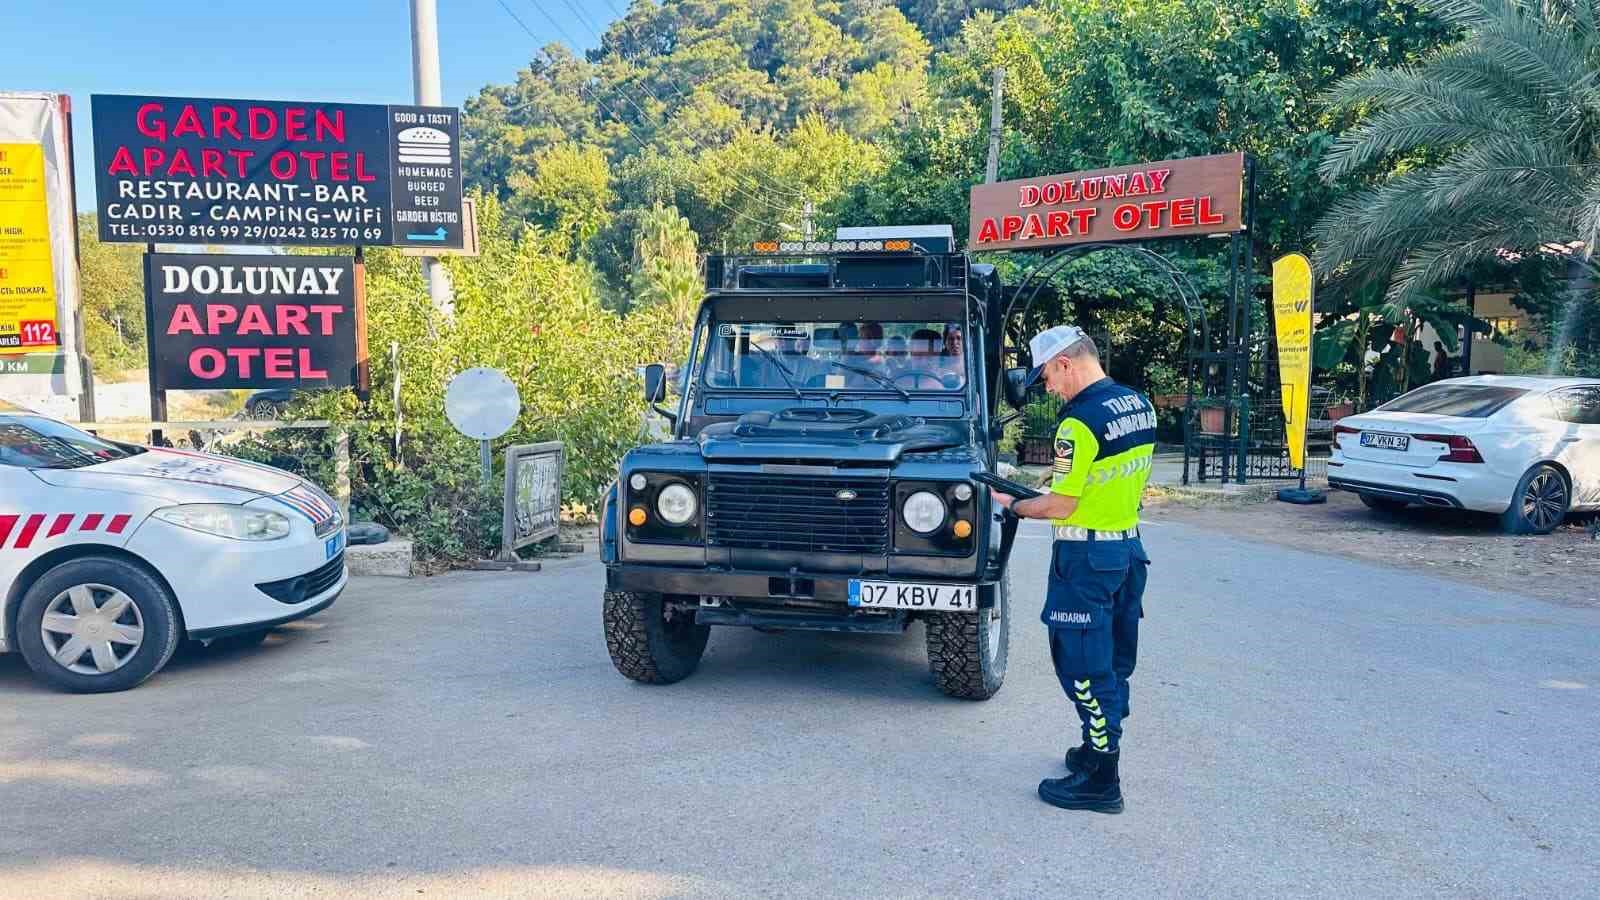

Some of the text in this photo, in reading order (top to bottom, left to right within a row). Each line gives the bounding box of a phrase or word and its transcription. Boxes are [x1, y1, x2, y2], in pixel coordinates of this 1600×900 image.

[136, 102, 346, 143] GARDEN
[394, 112, 417, 123] GOOD
[428, 114, 452, 125] TASTY
[108, 146, 376, 182] APART OTEL
[398, 167, 453, 178] HOMEMADE
[119, 180, 368, 203] RESTAURANT-BAR
[407, 181, 446, 192] BURGER
[1018, 169, 1170, 208] DOLUNAY
[414, 196, 439, 206] BEER
[107, 203, 184, 220] CADIR
[396, 210, 429, 223] GARDEN
[976, 196, 1224, 244] APART OTEL
[109, 224, 382, 240] TEL:0530 816 99 29/0242 825 70 69
[162, 265, 344, 295] DOLUNAY
[166, 303, 345, 336] APART
[23, 323, 52, 342] 112
[7, 362, 28, 372] KM
[187, 347, 329, 380] OTEL
[1396, 437, 1408, 448] 34
[862, 585, 888, 604] 07
[897, 586, 939, 607] KBV
[949, 588, 972, 609] 41
[1049, 610, 1092, 624] JANDARMA
